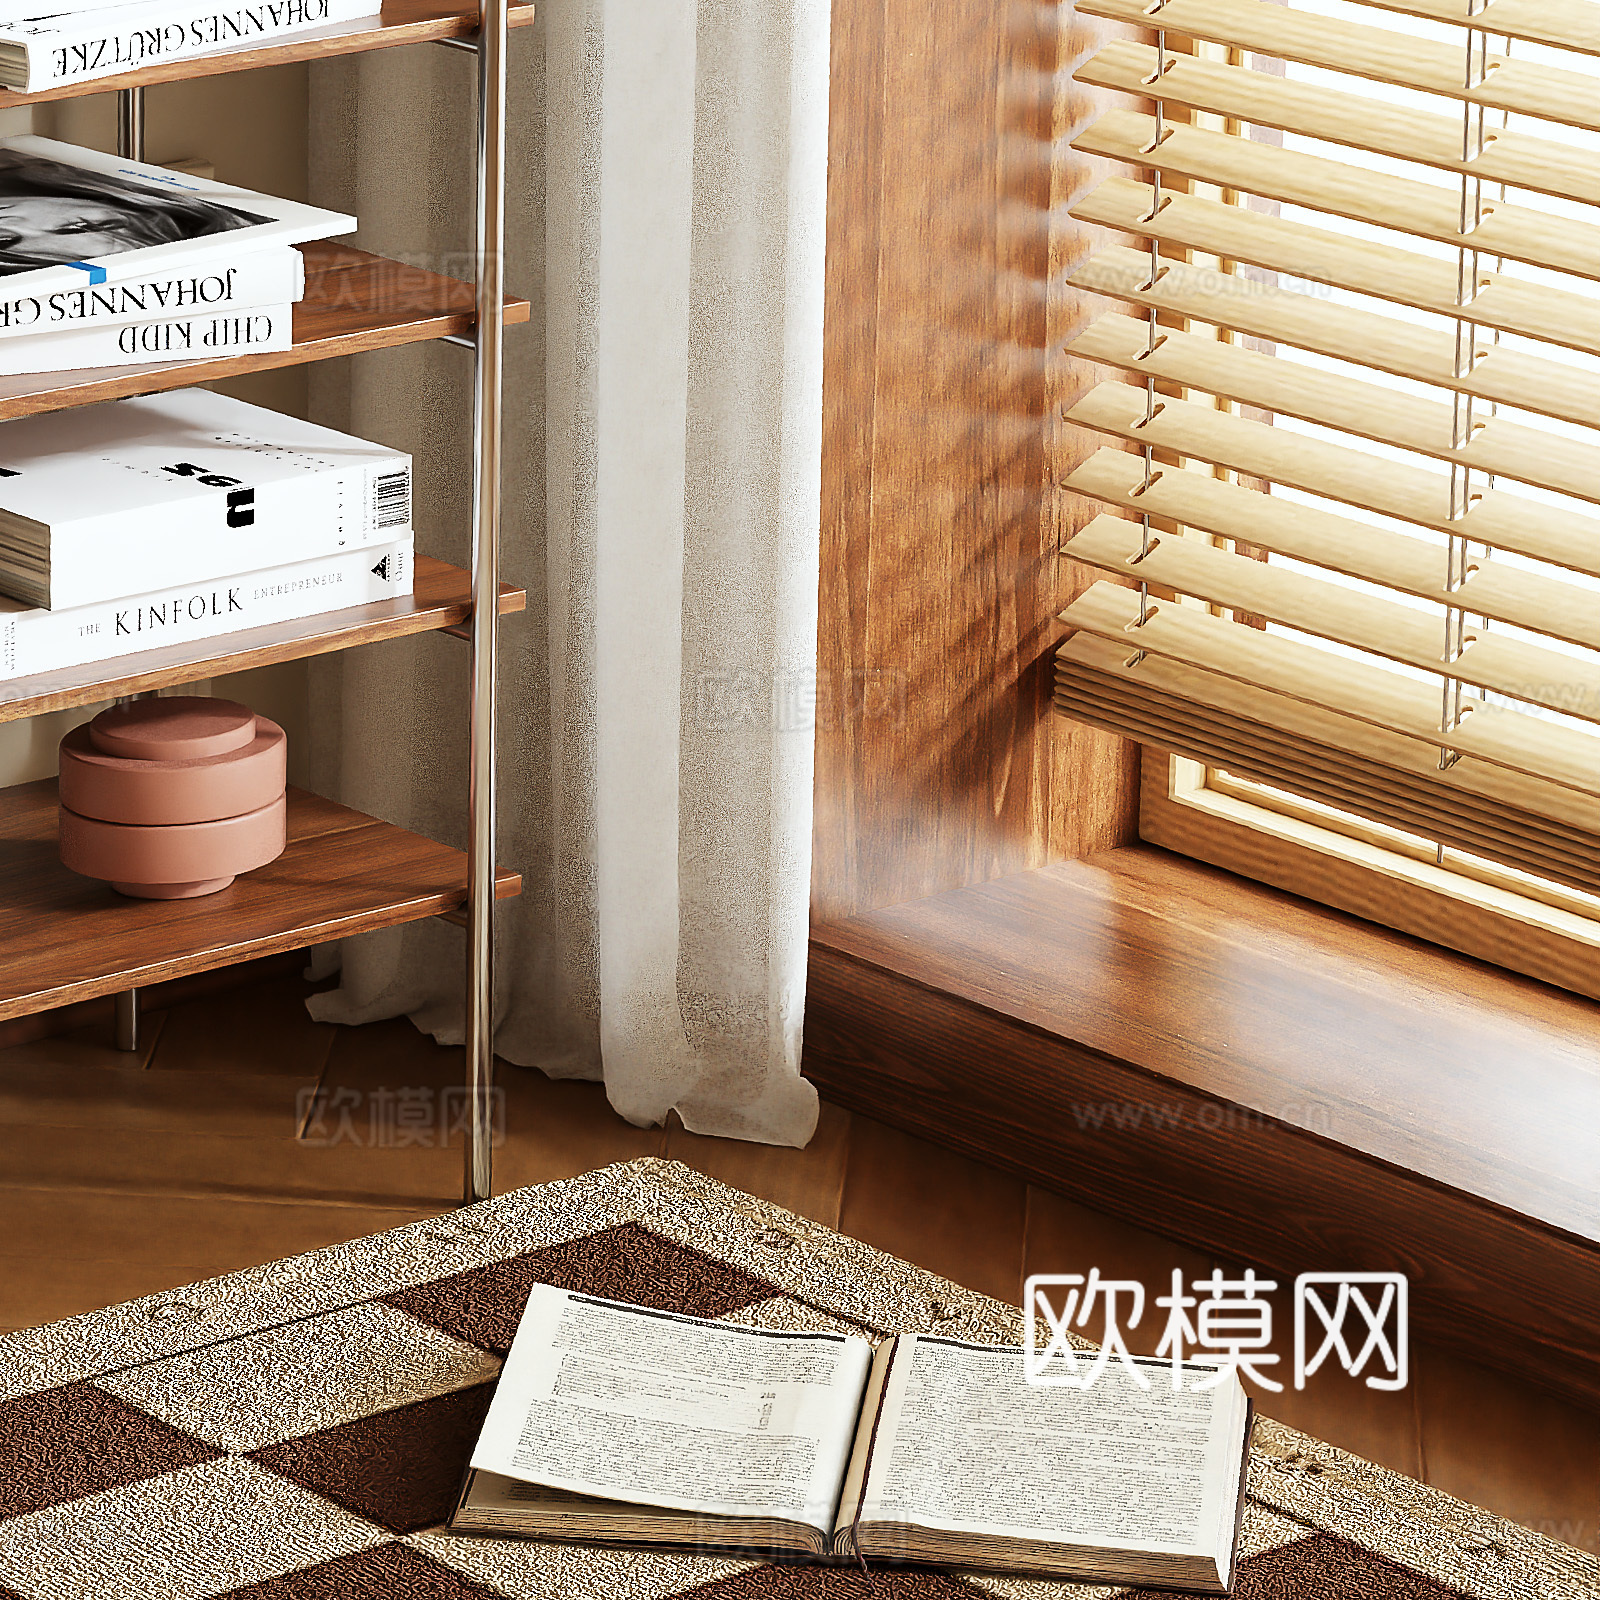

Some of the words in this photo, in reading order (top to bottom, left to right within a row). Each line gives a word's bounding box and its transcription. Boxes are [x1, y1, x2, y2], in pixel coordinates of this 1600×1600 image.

[52, 26, 187, 77] GRÜTZKE
[49, 267, 238, 320] JOHANNES
[118, 321, 191, 354] KIDD
[202, 315, 273, 346] CHIP
[77, 621, 102, 637] THE
[114, 587, 243, 637] KINFOLK
[253, 572, 344, 601] ENTREPRENEUR
